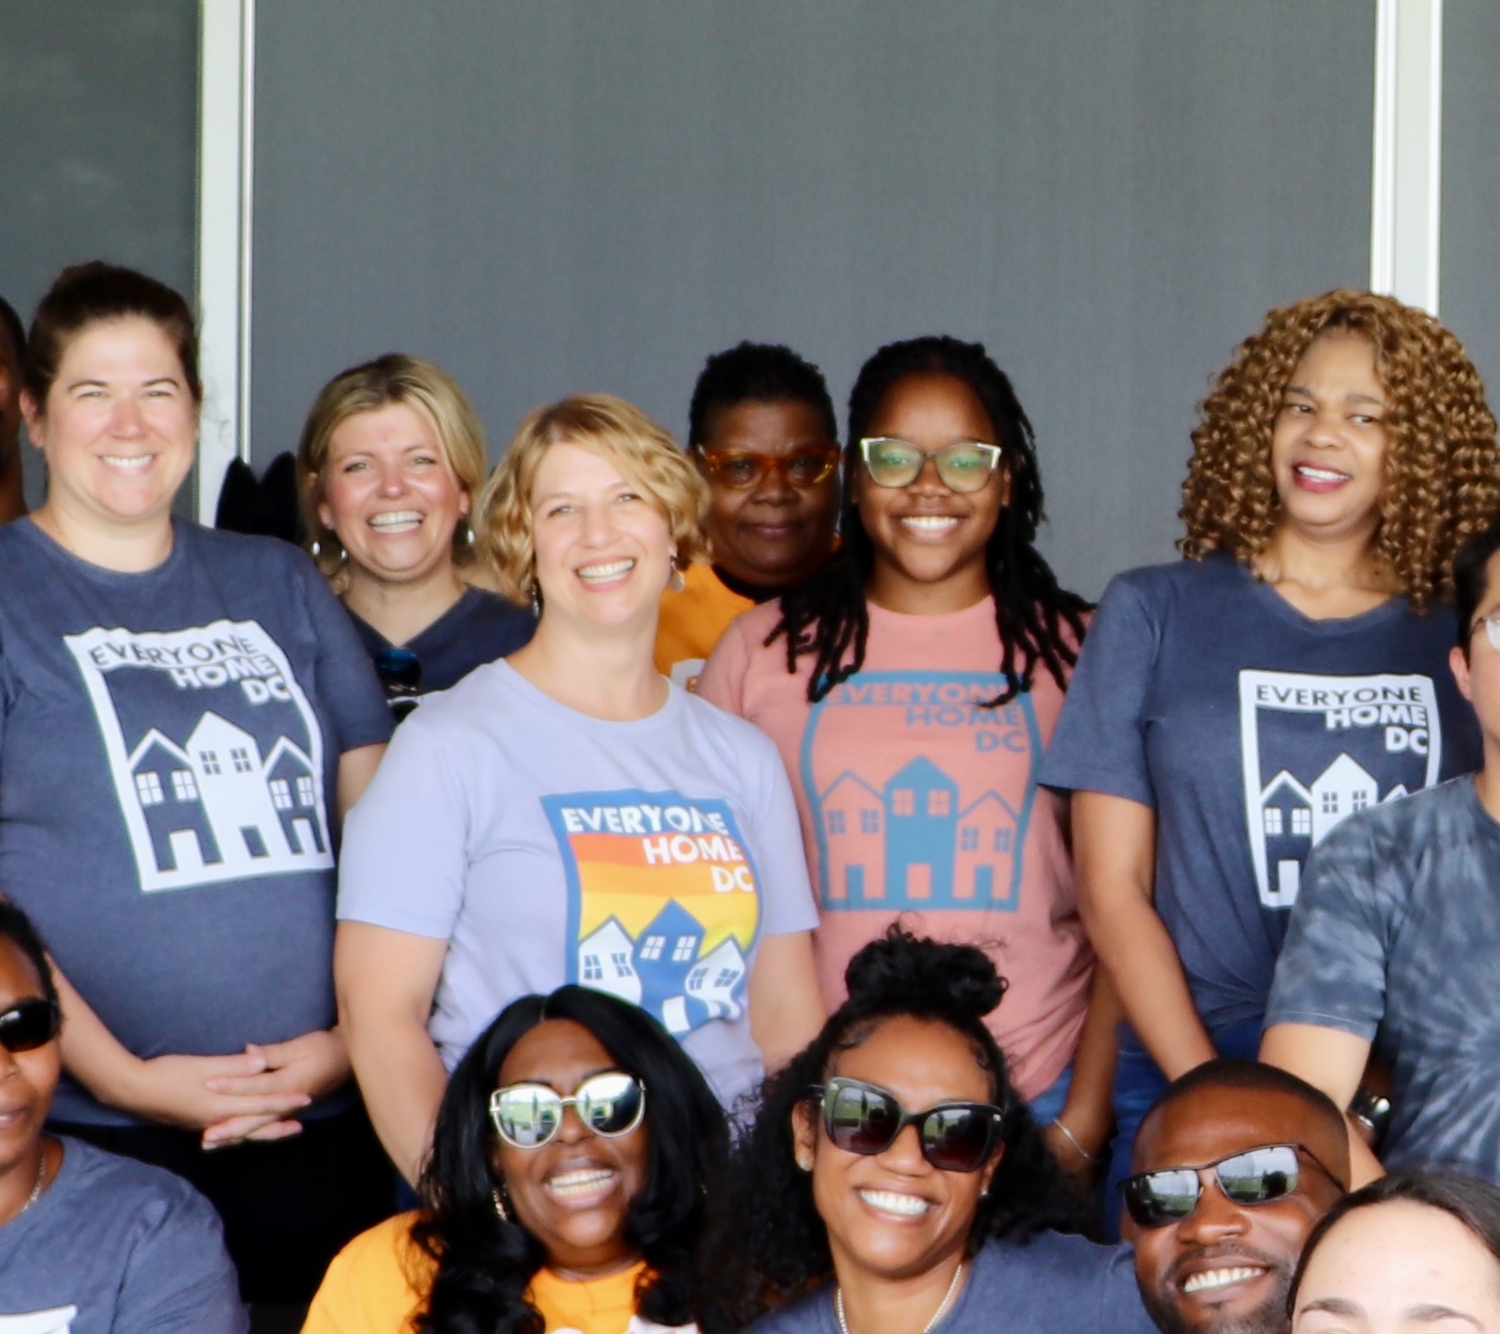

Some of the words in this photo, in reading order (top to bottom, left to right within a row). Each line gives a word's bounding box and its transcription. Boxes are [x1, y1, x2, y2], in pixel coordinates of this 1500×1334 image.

[88, 634, 258, 666] EVERYONE
[169, 655, 279, 690] HOME
[240, 675, 292, 705] DC
[827, 683, 1017, 704] EVERYON
[1256, 684, 1422, 705] EVERYONE
[905, 706, 1021, 727] HOME
[1325, 705, 1428, 729] HOME
[975, 730, 1026, 752] DC
[1385, 727, 1429, 755] DC
[561, 804, 729, 836] EVERYONE
[642, 835, 745, 865] HOME
[712, 866, 755, 893] DC
